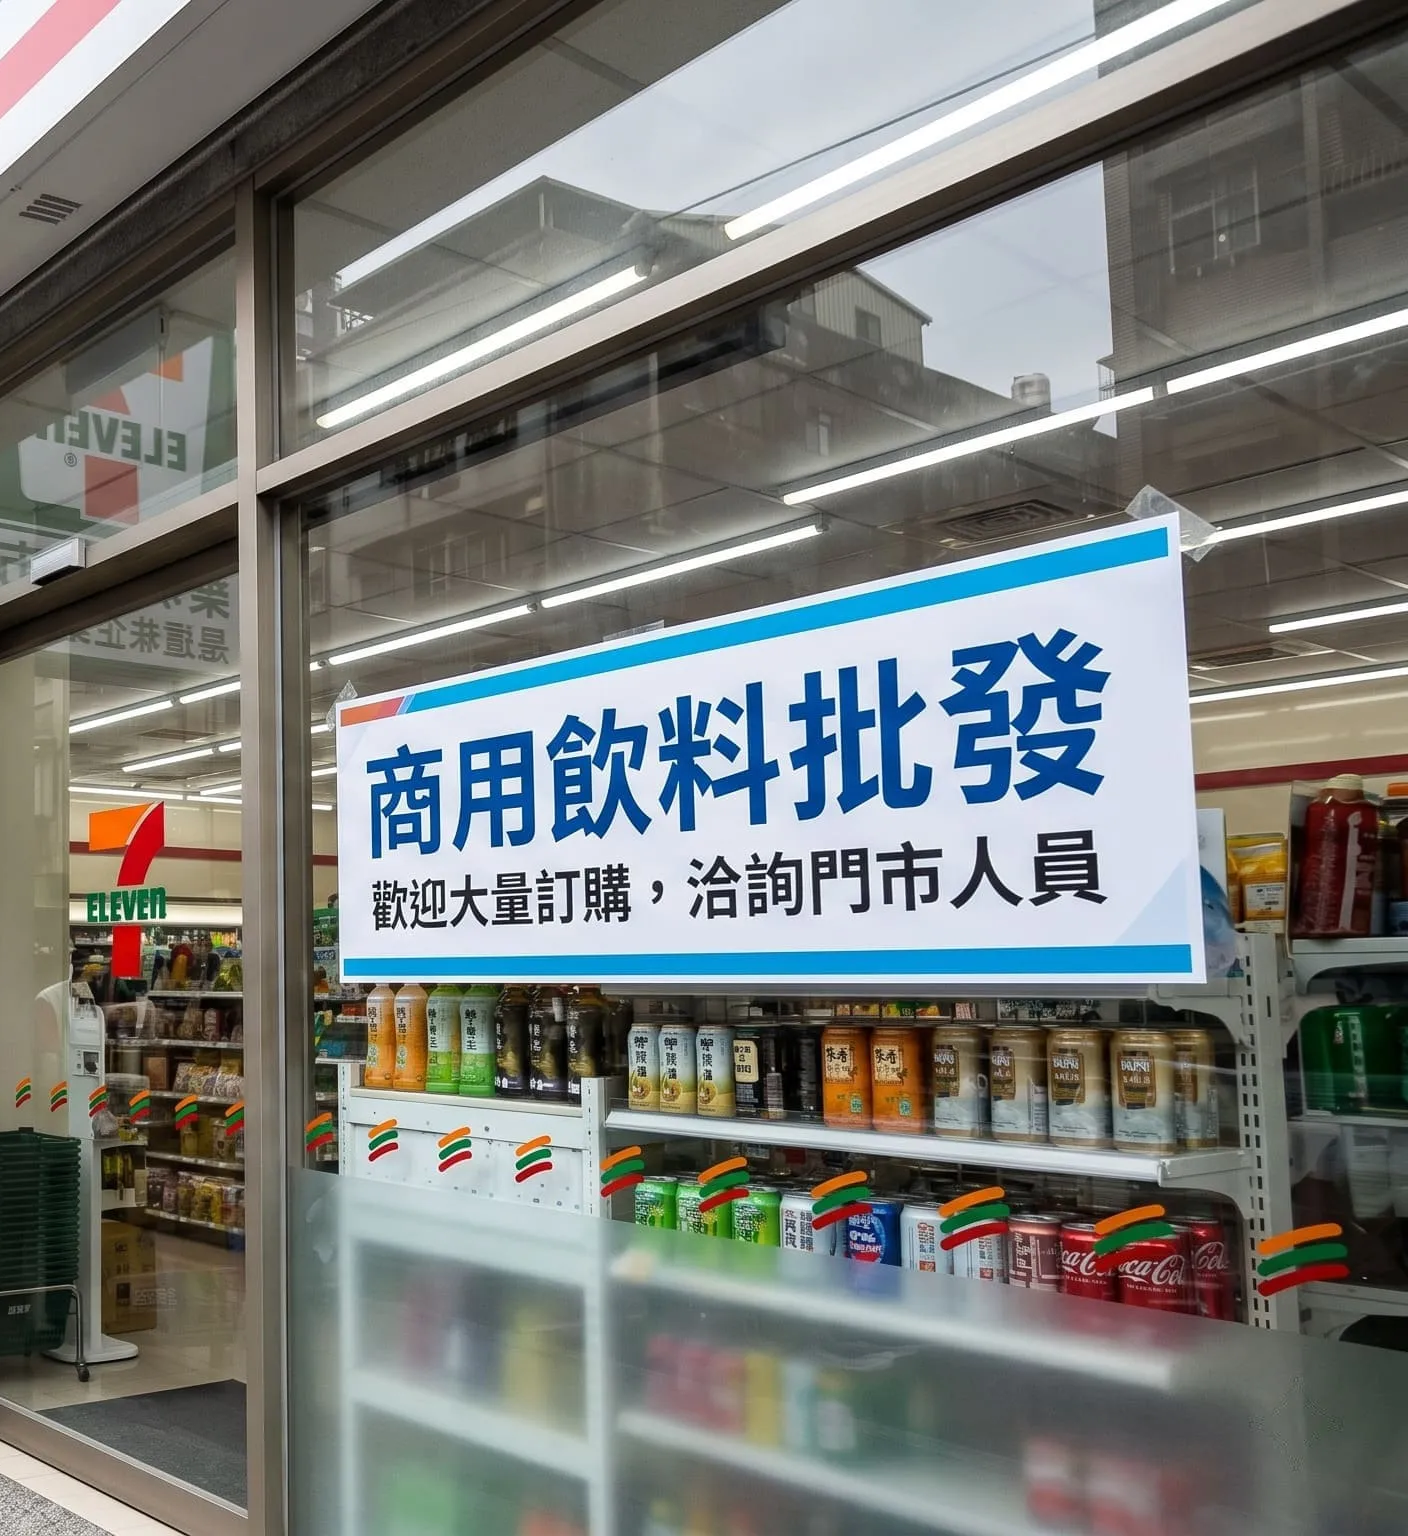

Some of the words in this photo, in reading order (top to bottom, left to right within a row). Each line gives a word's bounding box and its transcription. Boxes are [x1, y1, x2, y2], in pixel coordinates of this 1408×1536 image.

[366, 628, 1112, 860] 商用飲料批發
[87, 886, 167, 922] ELEVEn
[371, 829, 1109, 932] 歡迎大量訂購，洽詢門市人員
